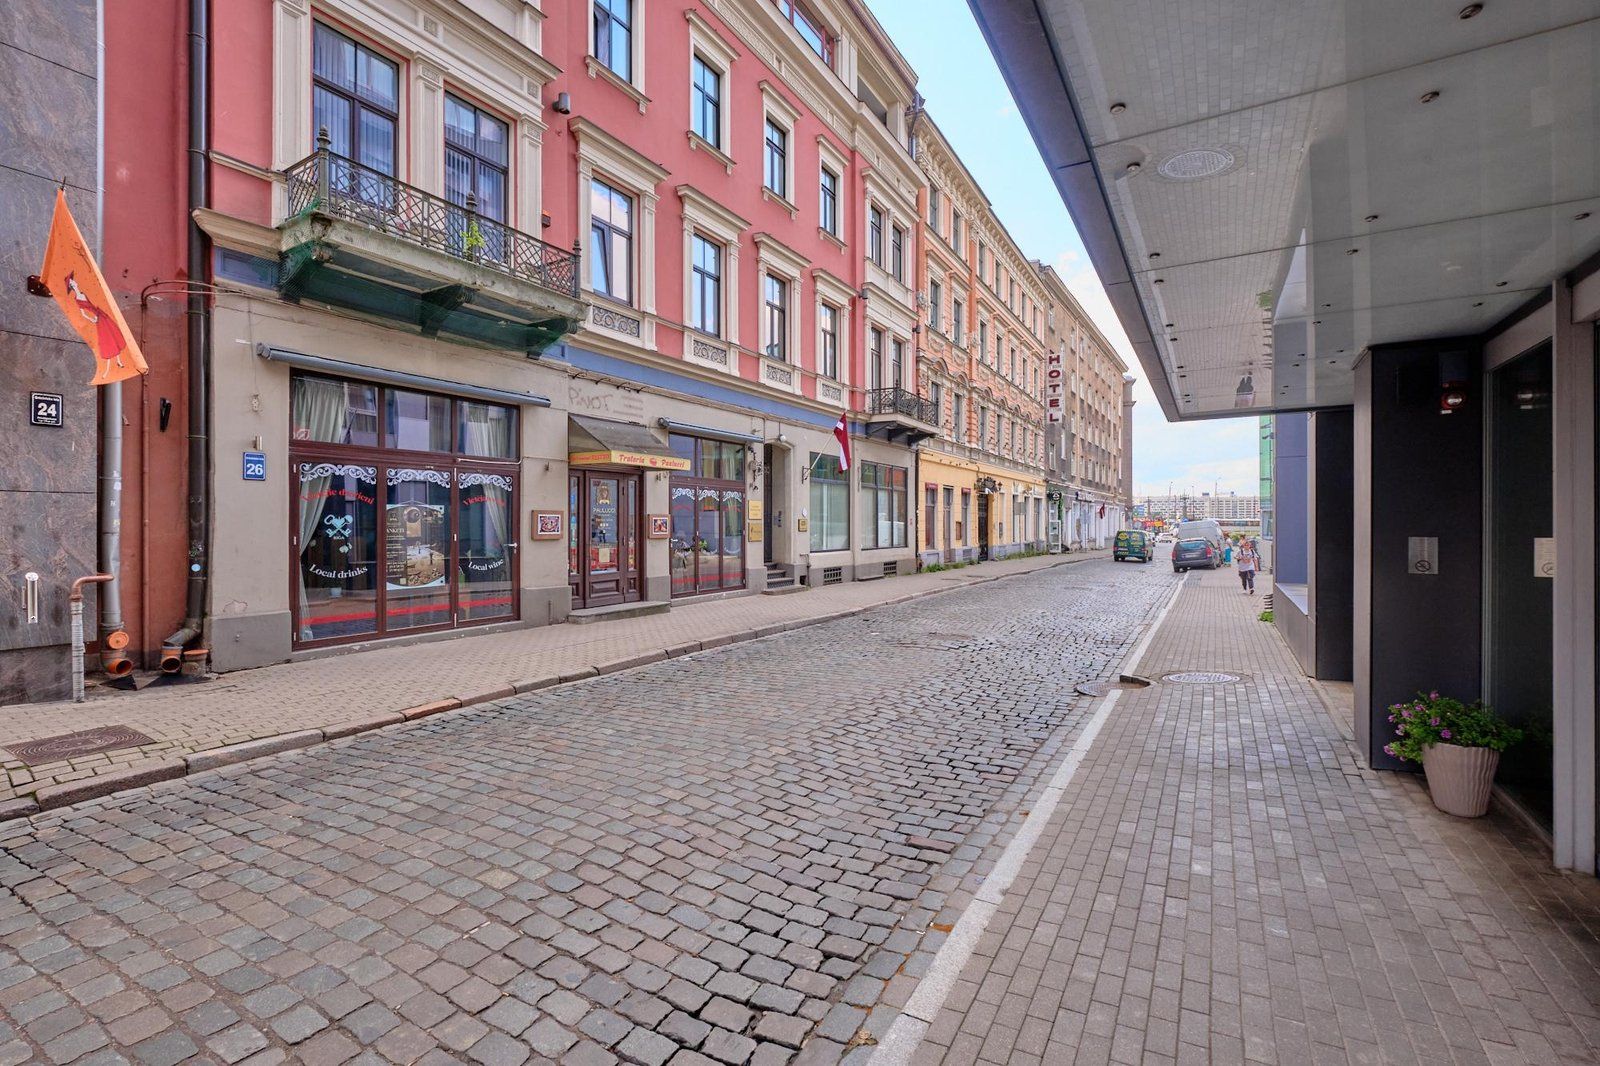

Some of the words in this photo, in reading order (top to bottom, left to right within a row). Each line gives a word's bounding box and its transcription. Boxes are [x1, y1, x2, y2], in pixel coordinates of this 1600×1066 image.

[1048, 354, 1061, 423] HOTEL
[37, 402, 57, 417] 24
[246, 463, 264, 475] 26
[309, 564, 336, 579] Local
[337, 566, 368, 579] drinks
[468, 561, 488, 571] Local
[488, 559, 505, 570] wine
